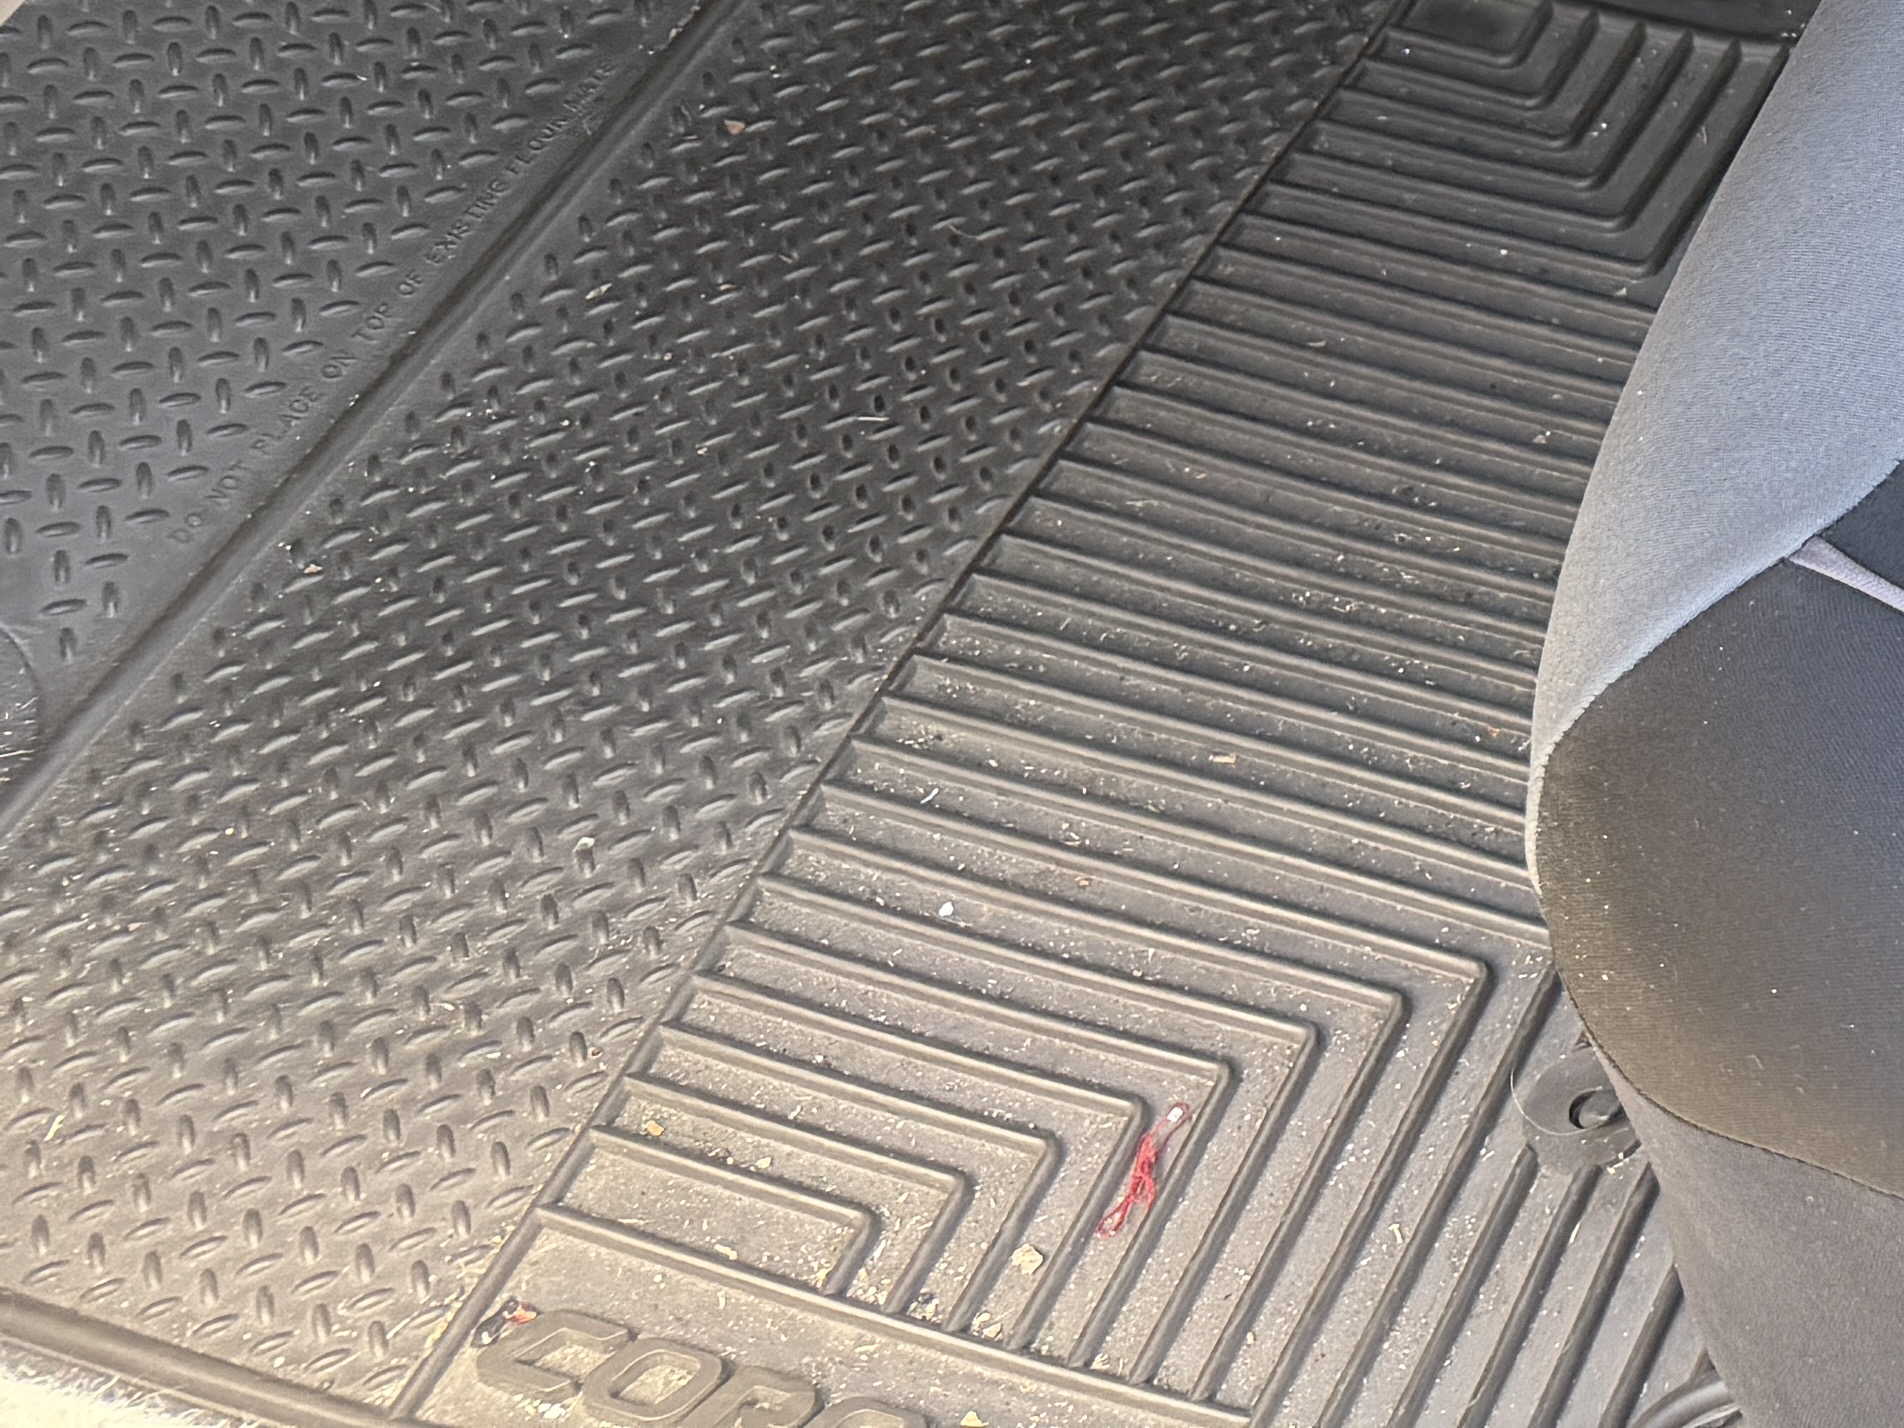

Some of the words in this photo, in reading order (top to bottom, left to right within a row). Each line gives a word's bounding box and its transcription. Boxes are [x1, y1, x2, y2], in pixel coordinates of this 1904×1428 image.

[167, 512, 204, 544] DO
[202, 459, 251, 505] NOT
[249, 385, 319, 455] PLACE
[320, 349, 359, 380] ON
[351, 302, 392, 343] TOP
[398, 269, 424, 297] OF
[422, 177, 510, 266] EXISTING
